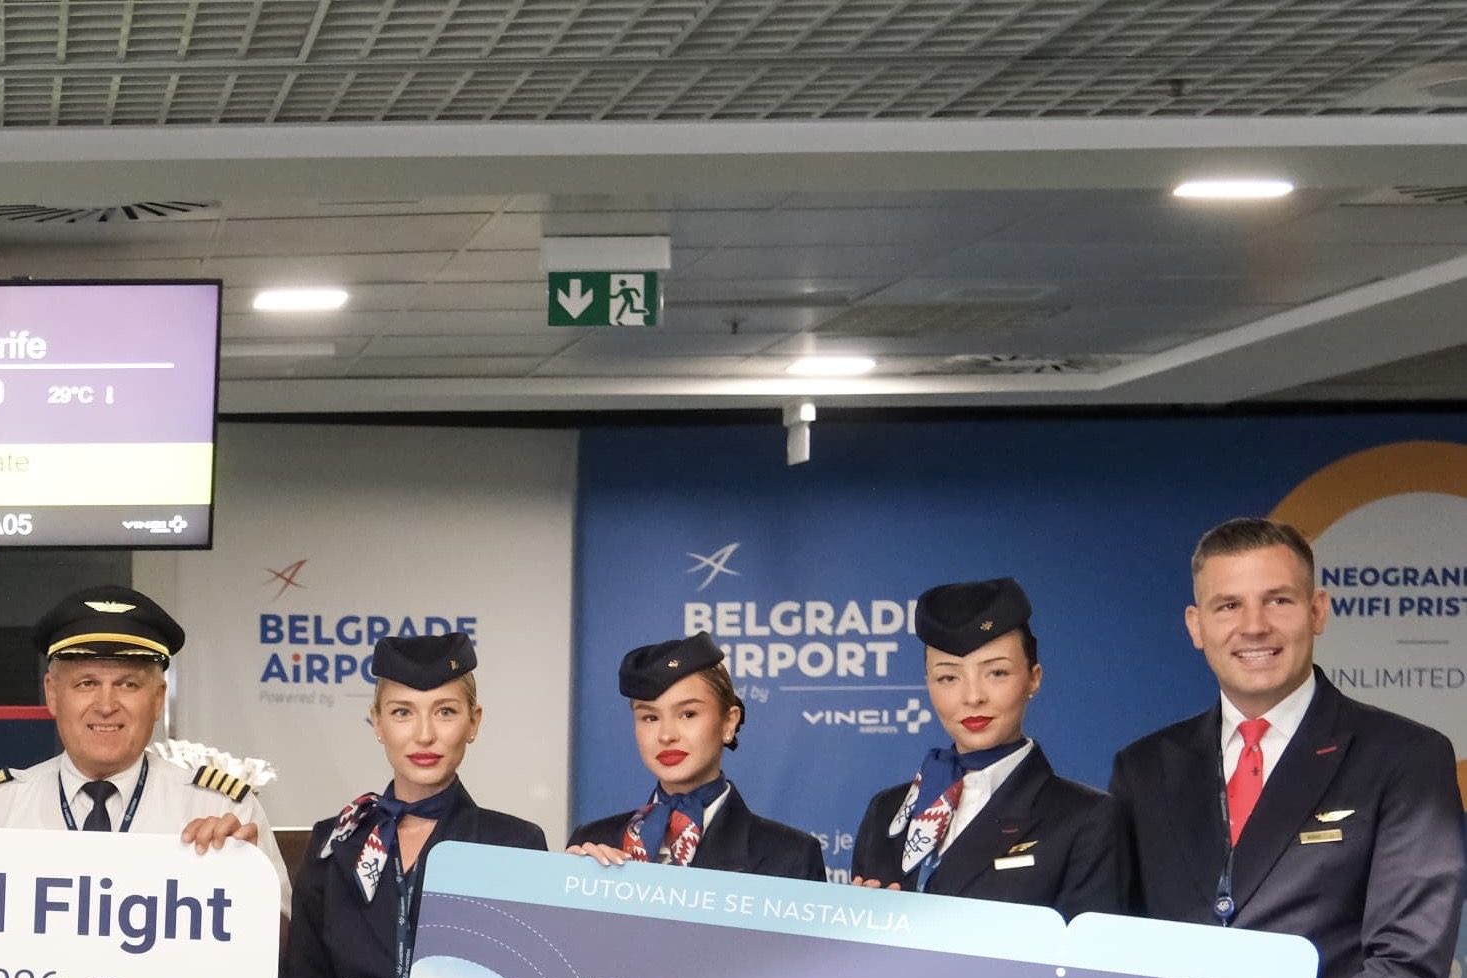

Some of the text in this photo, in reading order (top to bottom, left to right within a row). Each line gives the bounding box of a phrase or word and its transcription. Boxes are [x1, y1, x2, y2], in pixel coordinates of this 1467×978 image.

[48, 386, 94, 404] 29°C
[1331, 597, 1390, 616] WIFI
[260, 614, 478, 646] BELGRADE
[1333, 668, 1465, 689] NLIMITED
[751, 686, 769, 703] by
[802, 710, 889, 725] VINCI
[34, 875, 233, 954] Flight
[565, 875, 911, 934] PUTOVANJE SE NASTAVLJA
